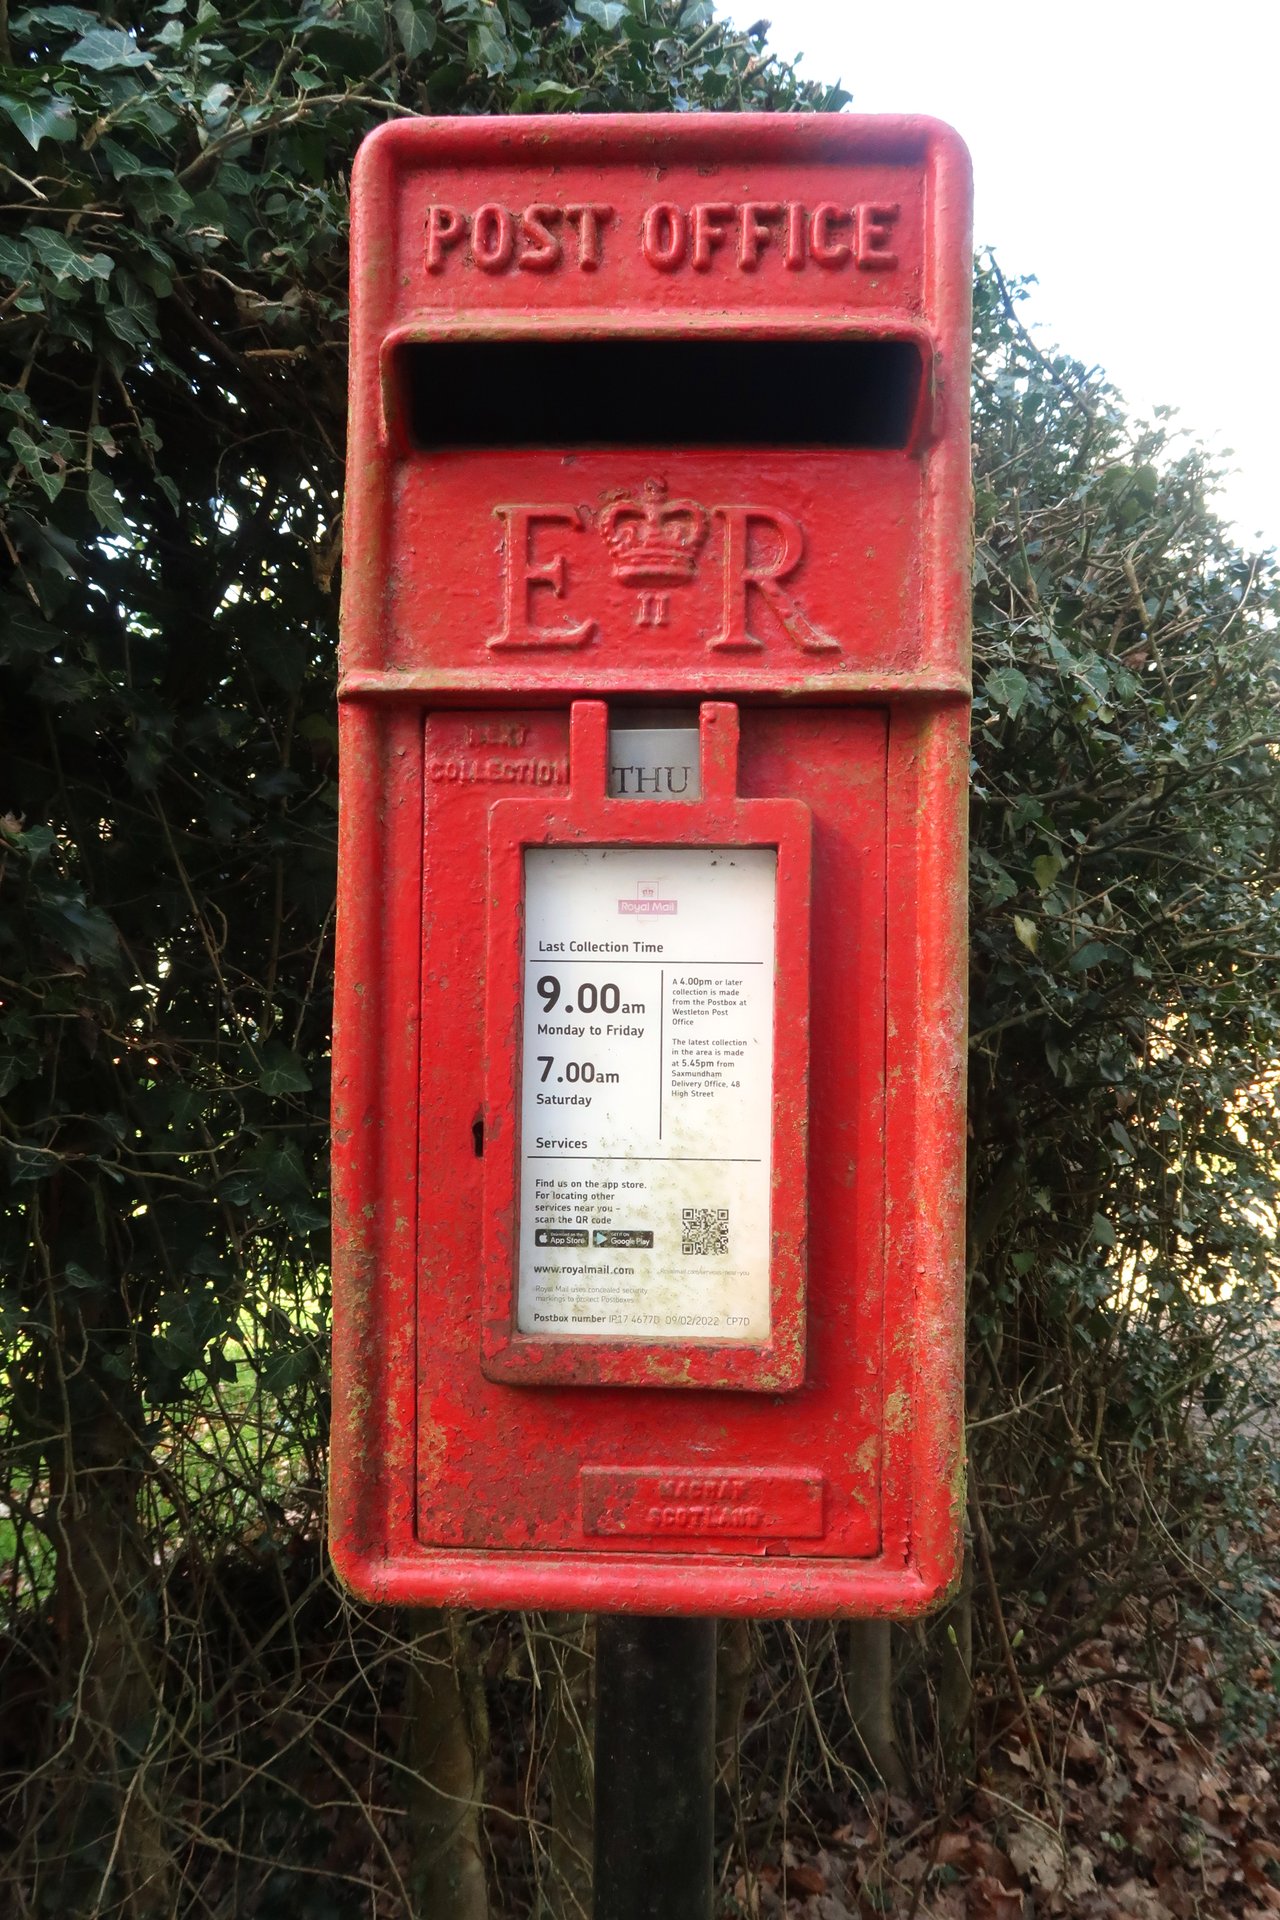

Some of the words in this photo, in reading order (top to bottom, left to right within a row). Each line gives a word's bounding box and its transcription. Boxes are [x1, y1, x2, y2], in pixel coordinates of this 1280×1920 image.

[424, 203, 613, 274] POST
[643, 202, 899, 272] OFFICE
[486, 504, 598, 653] E
[706, 504, 841, 653] R
[636, 591, 669, 627] II
[427, 757, 570, 783] COLLECTION
[611, 766, 692, 794] THU
[620, 901, 650, 913] Royal
[652, 902, 675, 912] Mail
[539, 940, 565, 952] Last
[569, 941, 629, 952] Collection
[633, 941, 664, 953] Time
[680, 977, 712, 987] 4.00pm
[537, 975, 645, 1013] 9.00am
[672, 1008, 710, 1016] Westleton
[712, 1008, 729, 1016] Post
[672, 1018, 694, 1026] Office
[537, 1024, 585, 1038] Monday
[590, 1025, 602, 1035] to
[606, 1024, 645, 1038] Friday
[671, 1048, 679, 1056] in
[681, 1048, 694, 1056] the
[537, 1056, 620, 1083] 7.00am
[681, 1059, 714, 1069] 5.45pm
[716, 1060, 735, 1068] from
[671, 1069, 722, 1077] Saxmundham
[671, 1080, 702, 1088] Delivery
[704, 1080, 728, 1088] Office,
[730, 1080, 741, 1088] 48
[671, 1090, 689, 1098] High
[536, 1093, 592, 1107] Saturday
[536, 1137, 588, 1149] Services
[535, 1179, 555, 1188] Find
[557, 1180, 568, 1188] us
[585, 1180, 600, 1188] the
[602, 1181, 619, 1190] app
[621, 1181, 647, 1189] store.
[535, 1191, 550, 1200] For
[552, 1191, 588, 1202] locating
[591, 1192, 615, 1200] other
[535, 1203, 571, 1211] services
[574, 1204, 595, 1212] near
[597, 1205, 613, 1214] you
[535, 1216, 555, 1224] scan
[558, 1216, 573, 1224] the
[575, 1216, 589, 1224] QR
[591, 1216, 612, 1224] code
[550, 1237, 565, 1245] App
[566, 1237, 585, 1245] Store
[610, 1237, 635, 1246] Google
[635, 1238, 651, 1246] Play
[533, 1265, 635, 1276] www.royalmail.com
[535, 1285, 554, 1294] Royal
[622, 1287, 648, 1296] security
[535, 1295, 566, 1303] markings
[576, 1296, 599, 1304] protect
[533, 1313, 569, 1322] Postbox
[571, 1314, 606, 1323] number
[608, 1315, 628, 1324] IP17
[665, 1316, 720, 1326] 09/02/2022
[726, 1316, 750, 1326] CP7D
[647, 1506, 761, 1528] SCOTLAND
